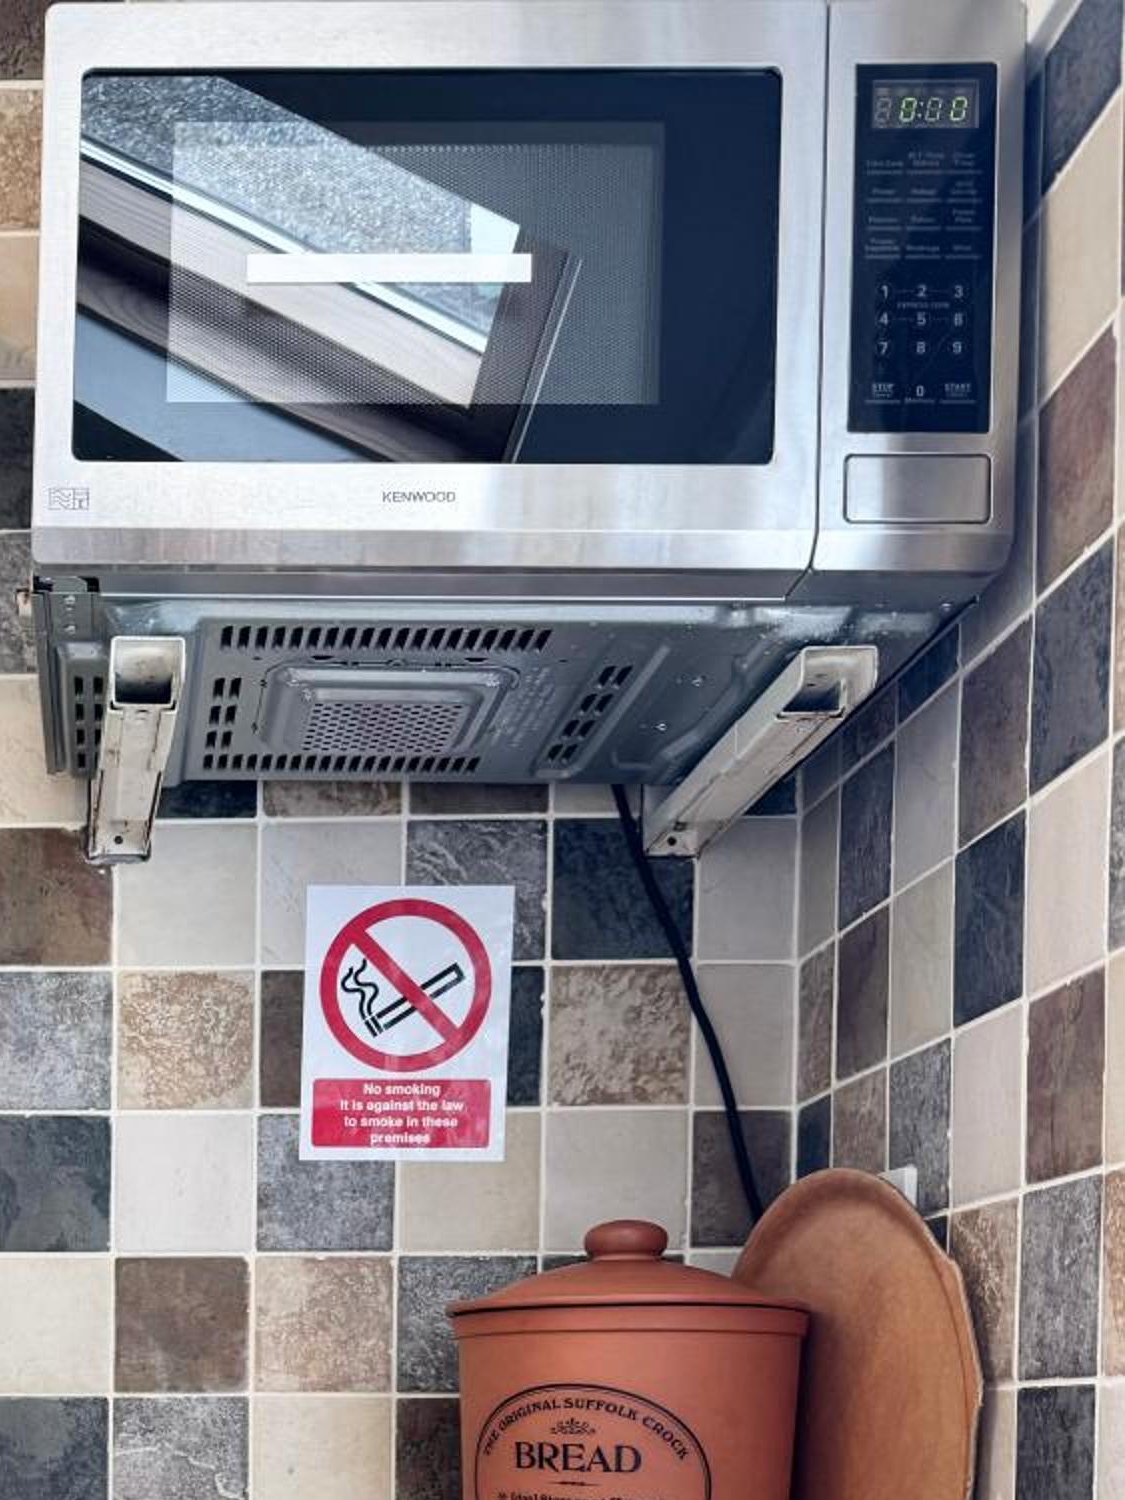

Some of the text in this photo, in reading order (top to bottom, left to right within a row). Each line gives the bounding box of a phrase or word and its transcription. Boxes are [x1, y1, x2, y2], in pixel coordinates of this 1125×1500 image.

[881, 284, 964, 299] 1 2 3
[879, 312, 889, 326] 4
[917, 312, 926, 326] 5
[879, 341, 962, 355] 7 8 9
[916, 385, 925, 397] 0
[382, 491, 456, 503] KENWOOD
[363, 1083, 441, 1098] No smoking
[340, 1100, 464, 1114] It is against the law
[344, 1116, 458, 1128] to smoke in these
[370, 1132, 431, 1145] premises
[483, 1397, 690, 1461] THE ORIGINAL SUFFOLK CROCK
[514, 1441, 642, 1474] BREAD
